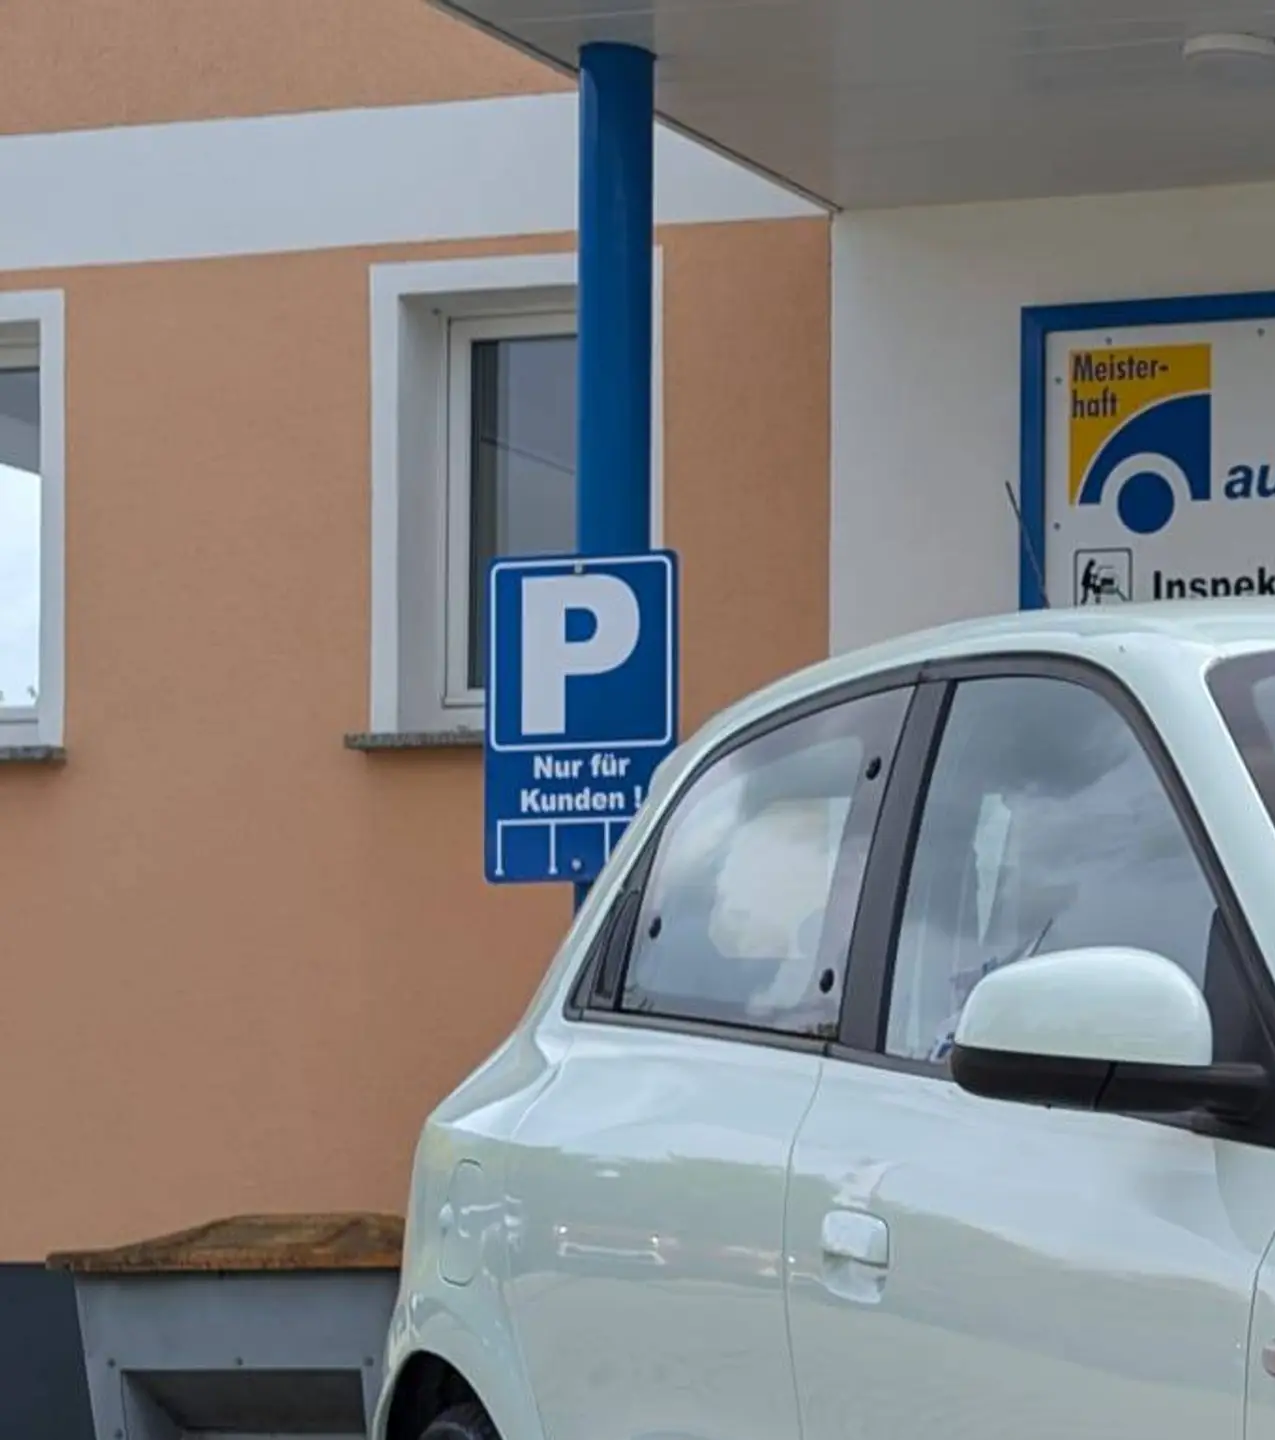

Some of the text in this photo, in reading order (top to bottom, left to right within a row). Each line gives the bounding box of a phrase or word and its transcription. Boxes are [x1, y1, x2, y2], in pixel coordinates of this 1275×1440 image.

[1072, 352, 1169, 383] Meister-
[1071, 388, 1118, 419] haft
[521, 573, 641, 736] P
[533, 753, 631, 779] Nur für
[521, 787, 625, 812] Kunden
